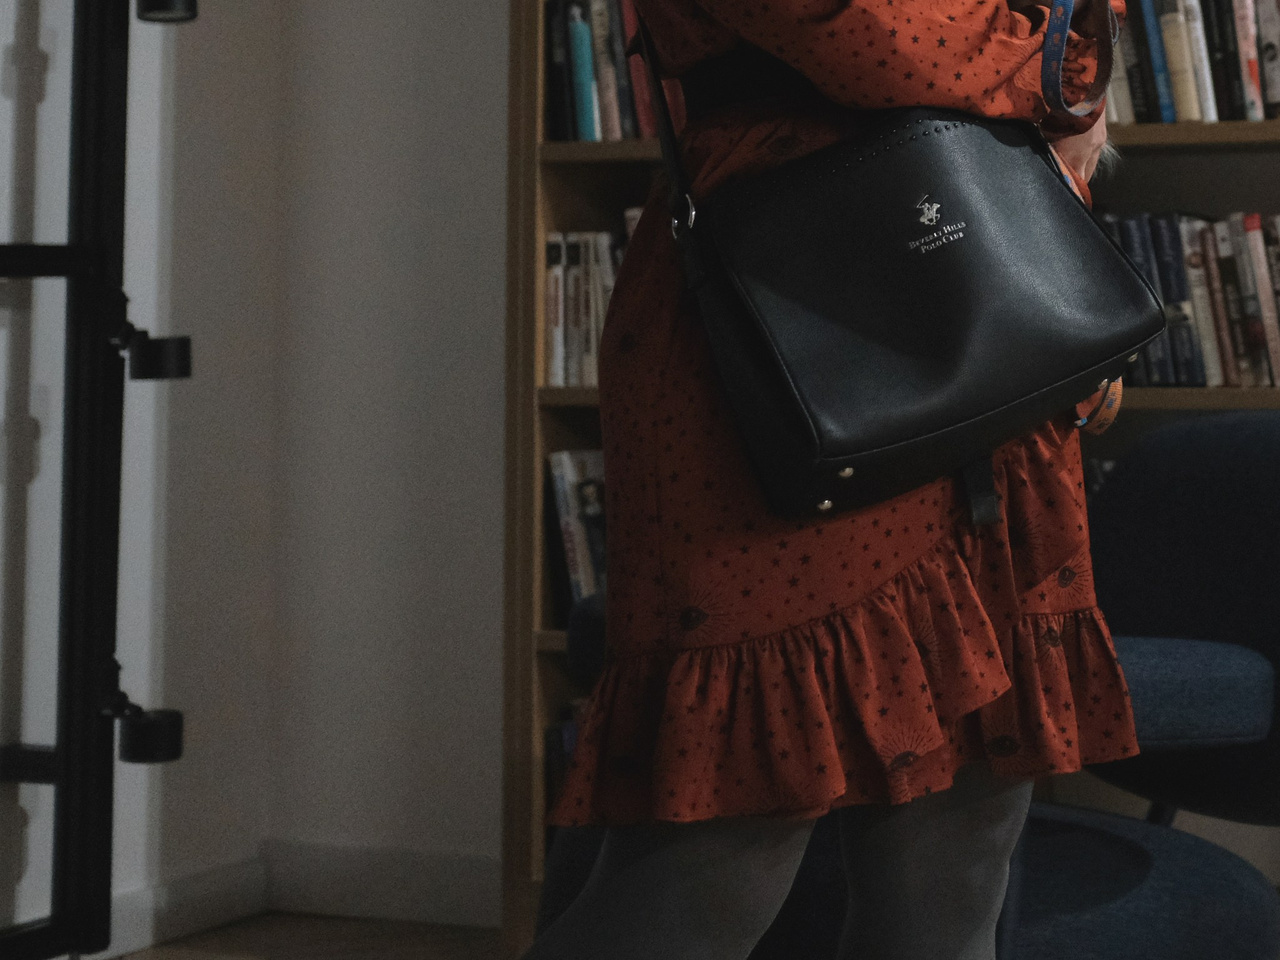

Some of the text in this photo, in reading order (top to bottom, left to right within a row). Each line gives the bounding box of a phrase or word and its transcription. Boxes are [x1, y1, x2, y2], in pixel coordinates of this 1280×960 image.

[942, 221, 967, 234] HILLS
[920, 231, 964, 253] POLO CLUB
